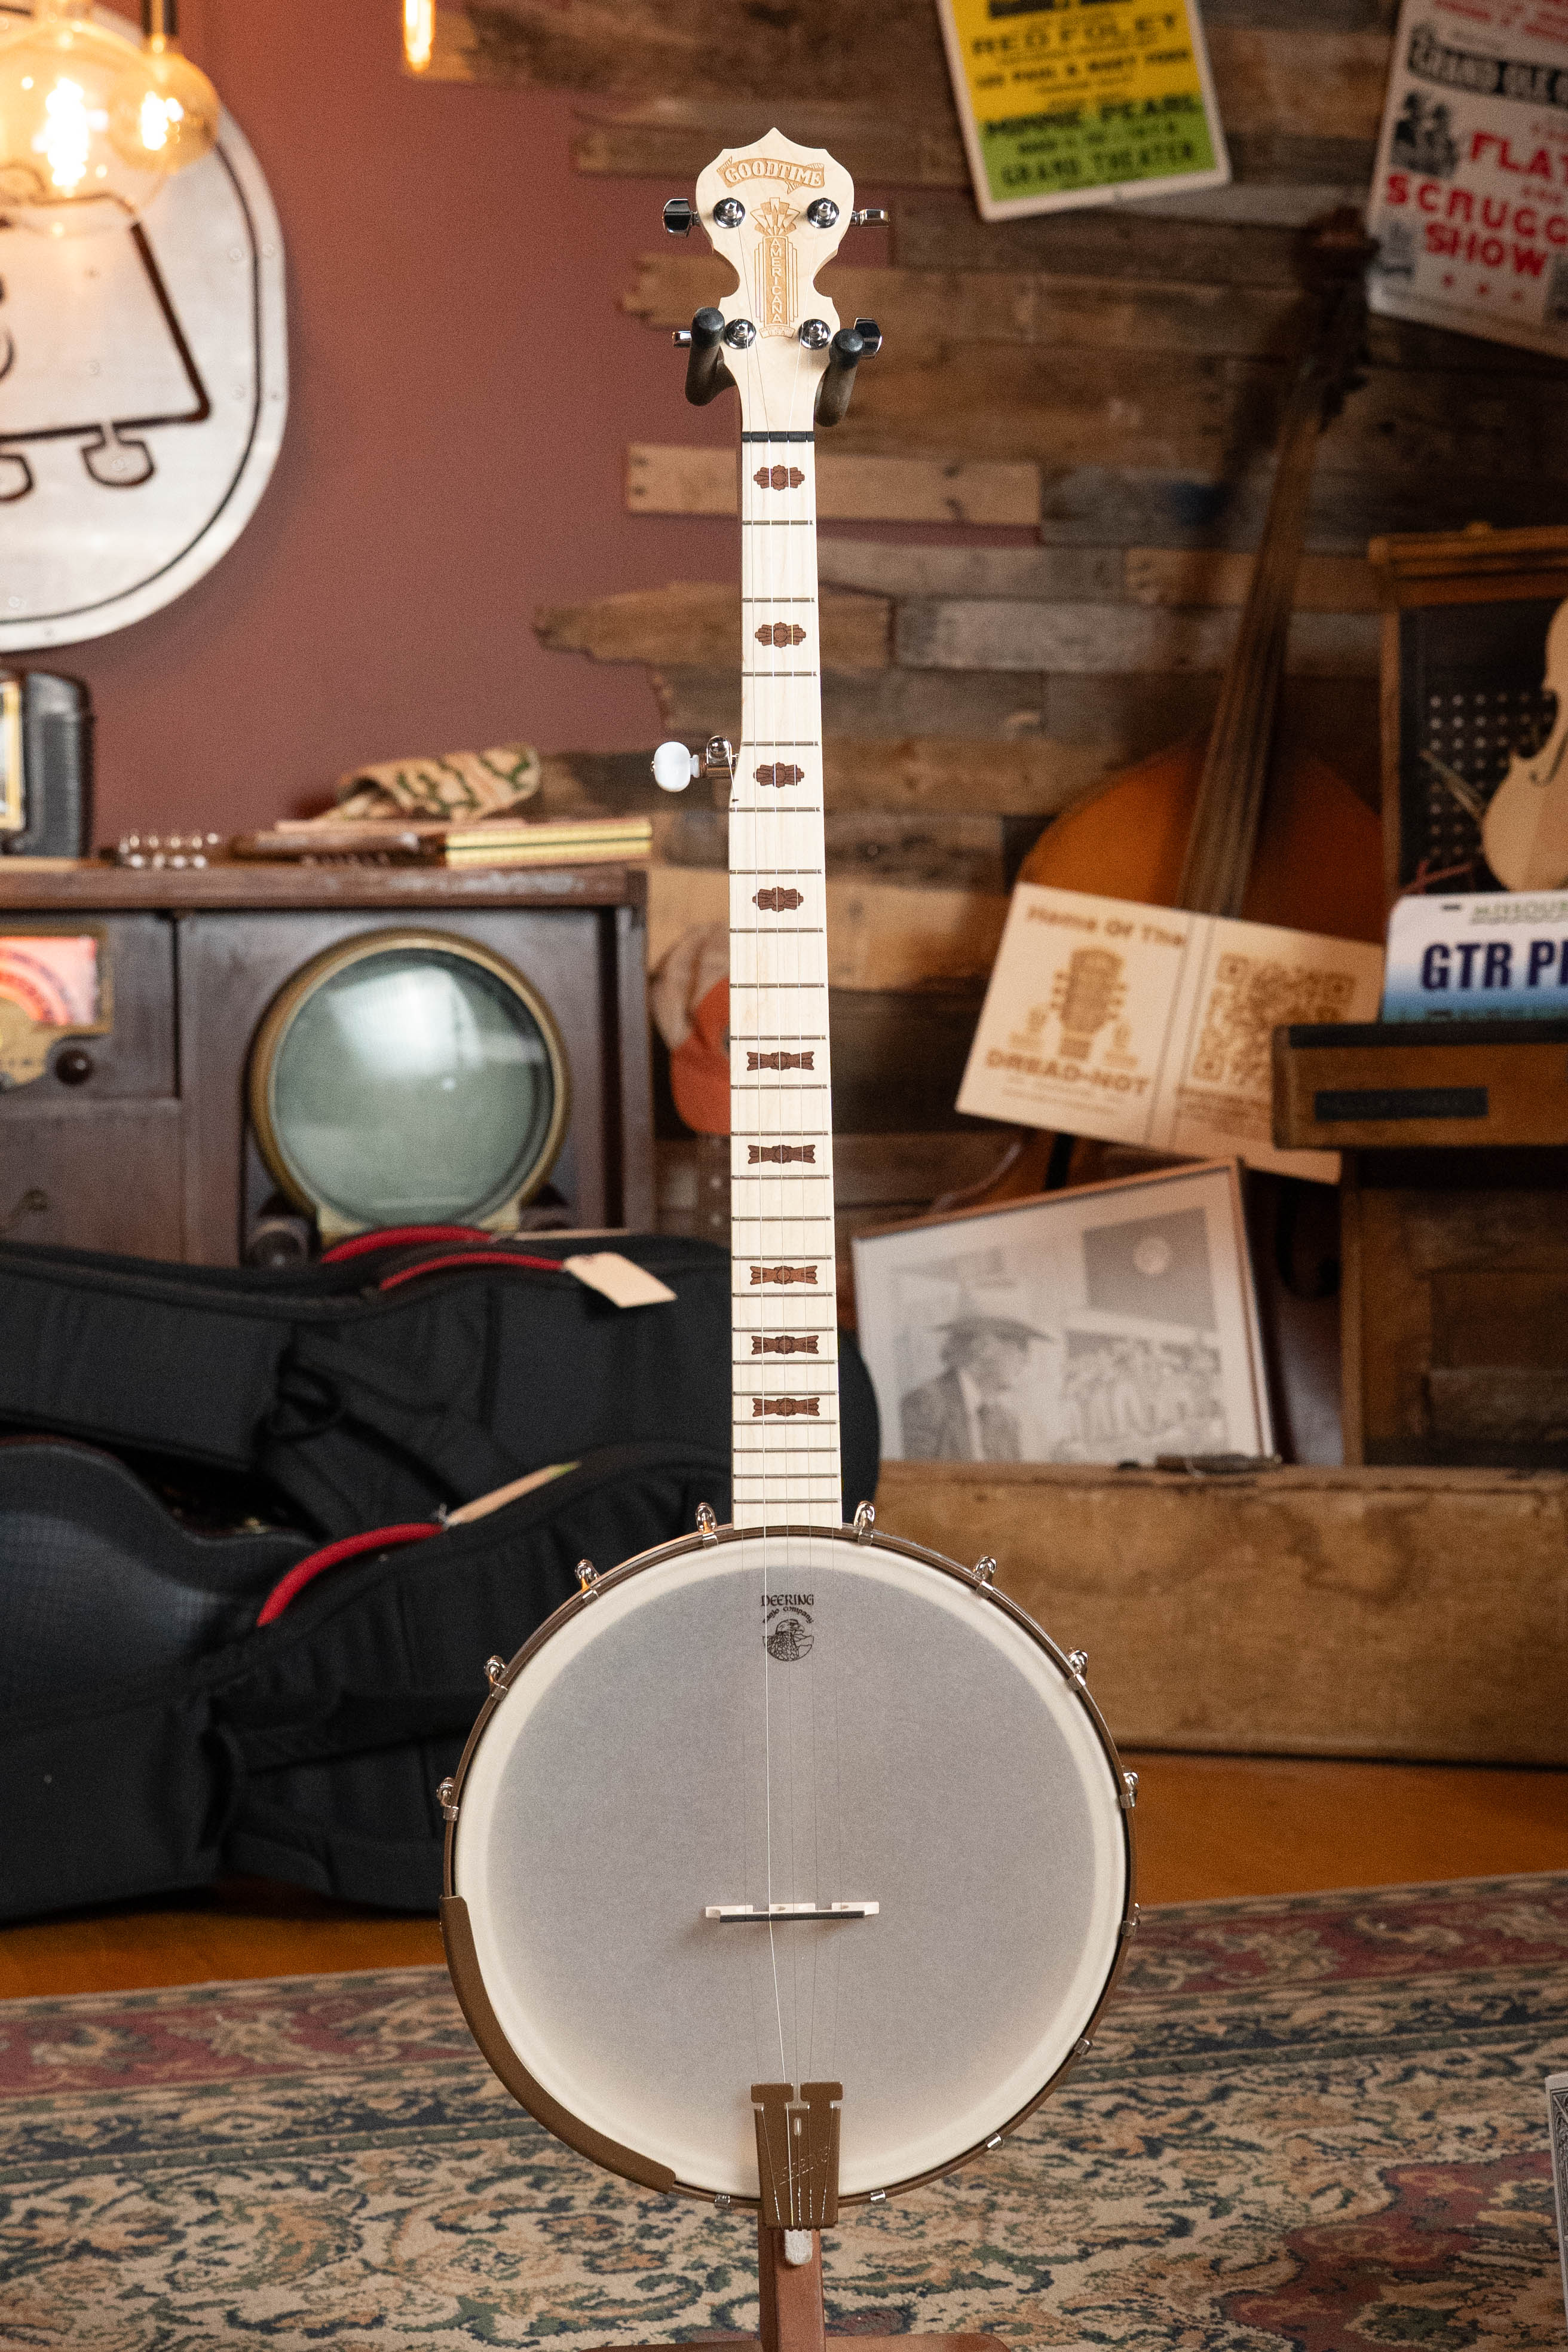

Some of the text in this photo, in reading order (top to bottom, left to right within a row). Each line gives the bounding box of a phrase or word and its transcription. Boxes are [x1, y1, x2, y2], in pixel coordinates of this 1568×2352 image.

[725, 161, 822, 186] GOODTIME
[1424, 222, 1548, 277] SHOW
[770, 239, 783, 323] AMERICANA
[1420, 942, 1512, 991] GTR
[985, 1048, 1150, 1095] DREAD-NOT
[761, 1594, 813, 1606] DEERING
